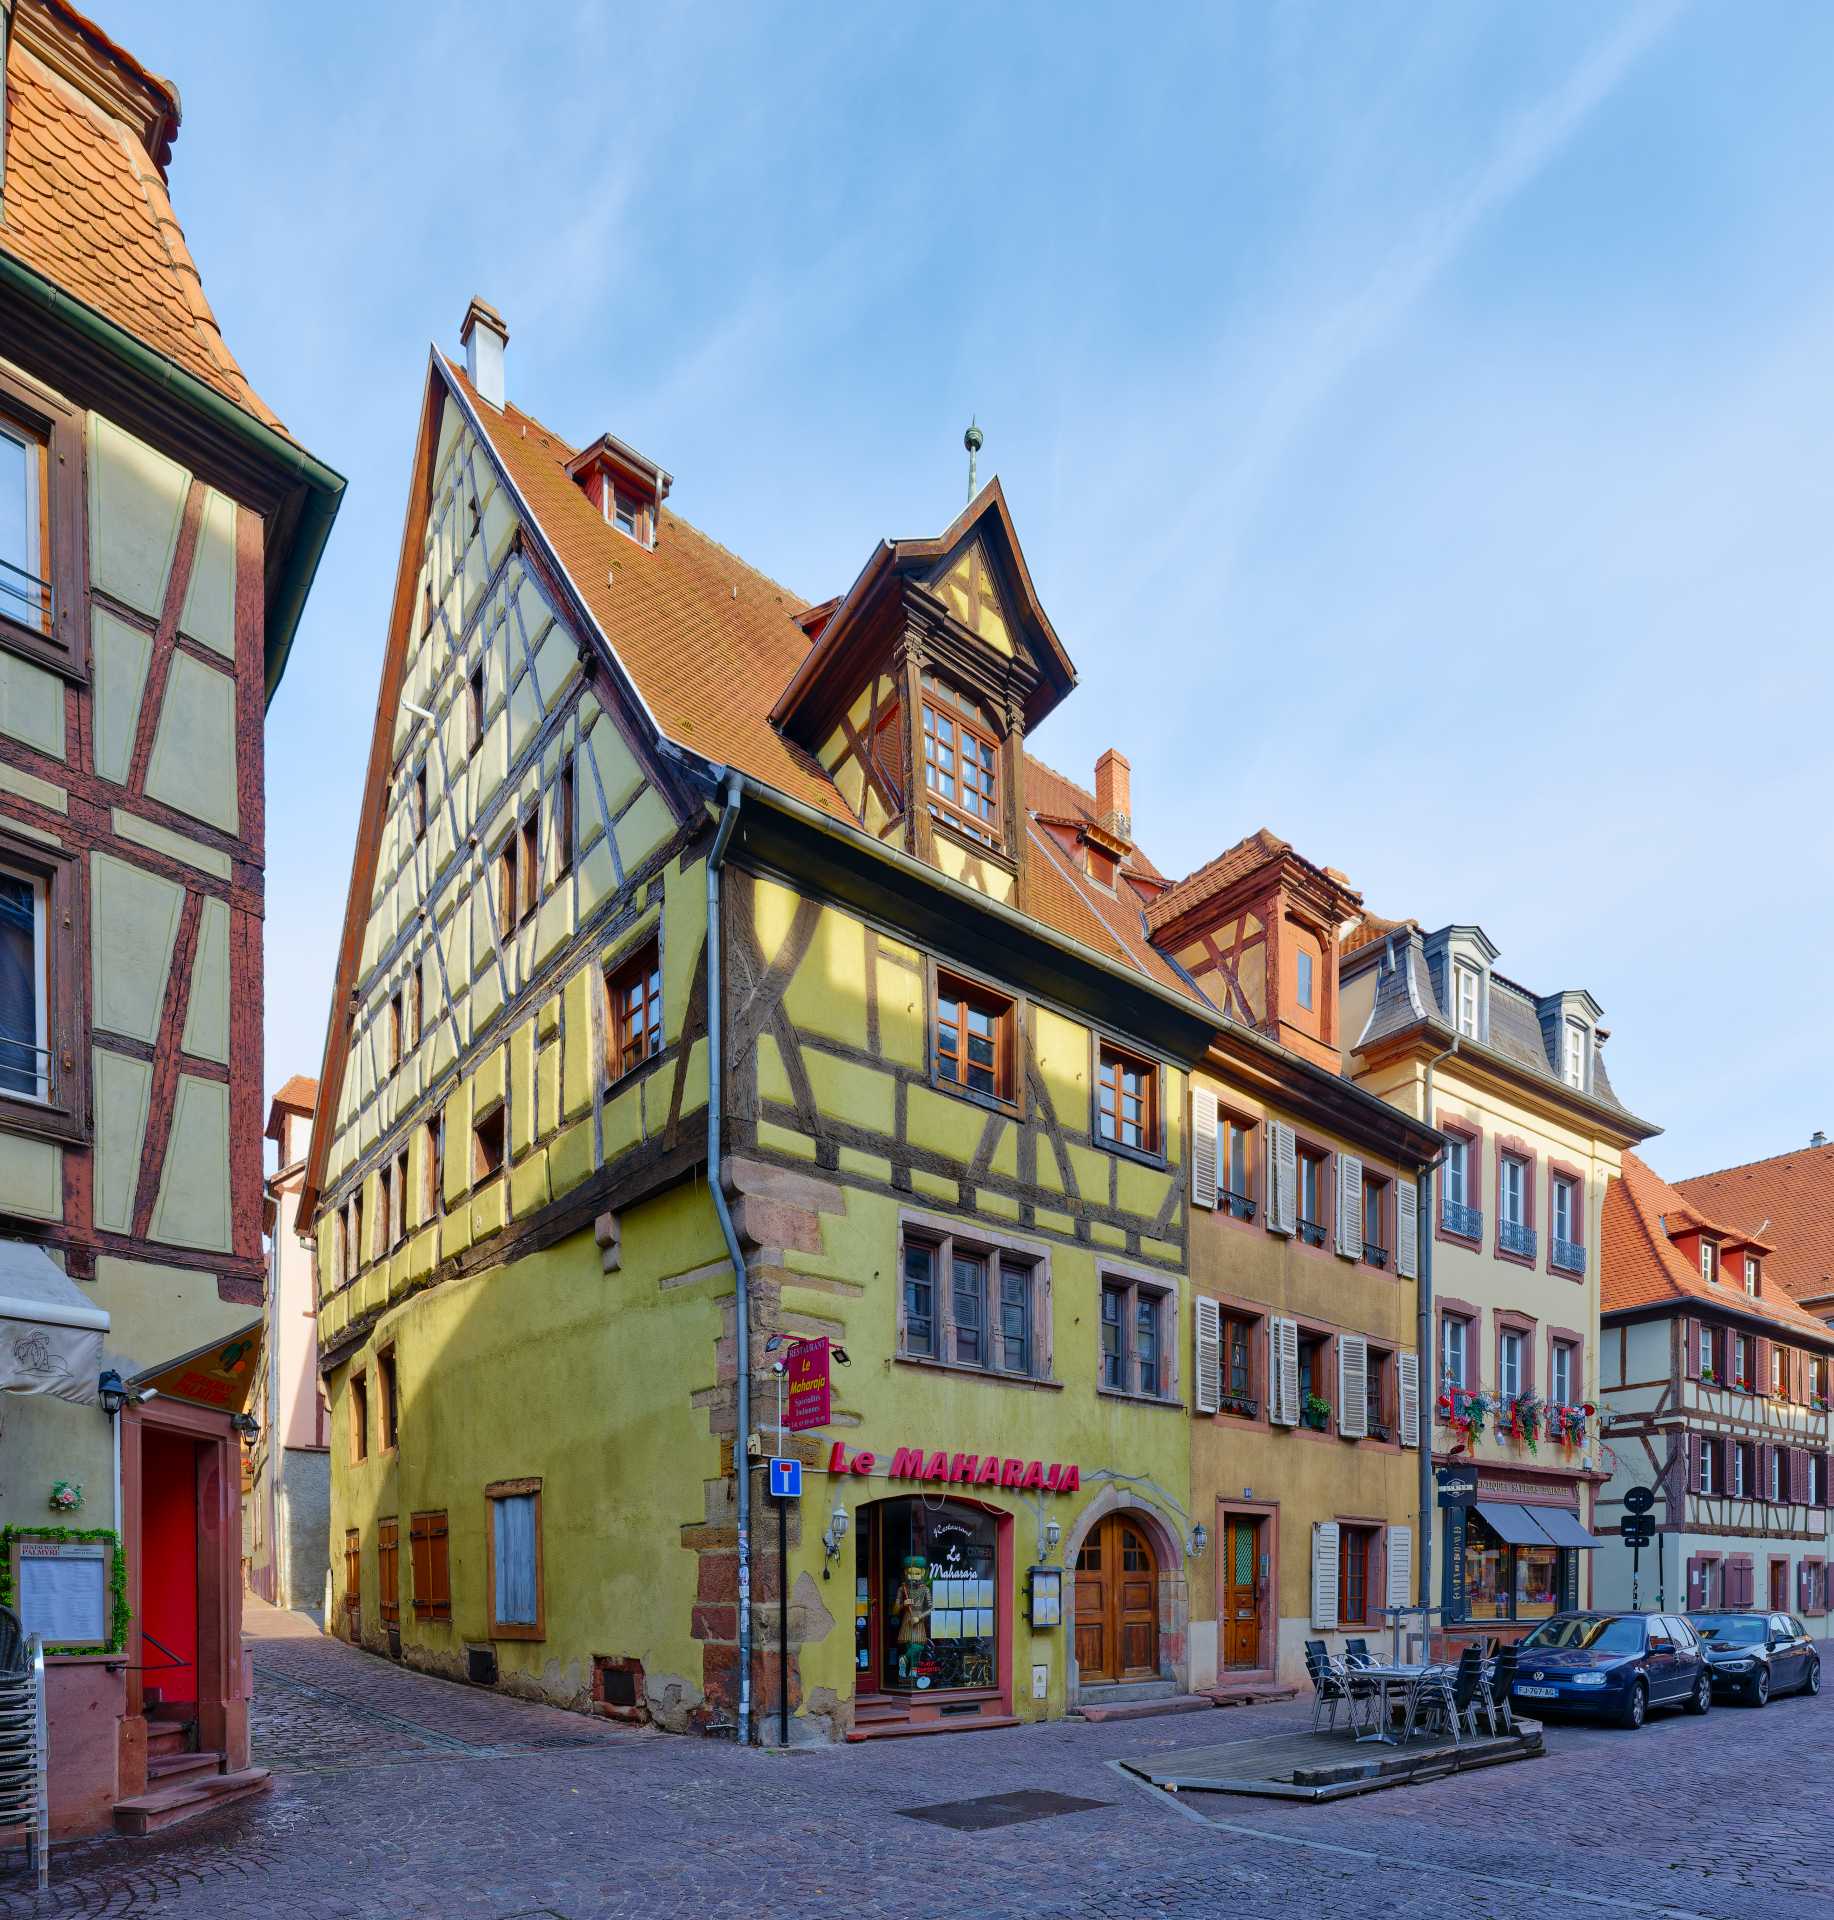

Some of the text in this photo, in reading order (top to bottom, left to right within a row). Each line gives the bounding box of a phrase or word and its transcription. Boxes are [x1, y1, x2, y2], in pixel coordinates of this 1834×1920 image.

[789, 1340, 825, 1358] RESTAURANT
[802, 1358, 811, 1372] Le
[790, 1374, 826, 1393] Maharaja
[828, 1441, 1080, 1492] Le MAHARAJA
[946, 1544, 961, 1562] Le
[929, 1562, 978, 1581] Maharaja
